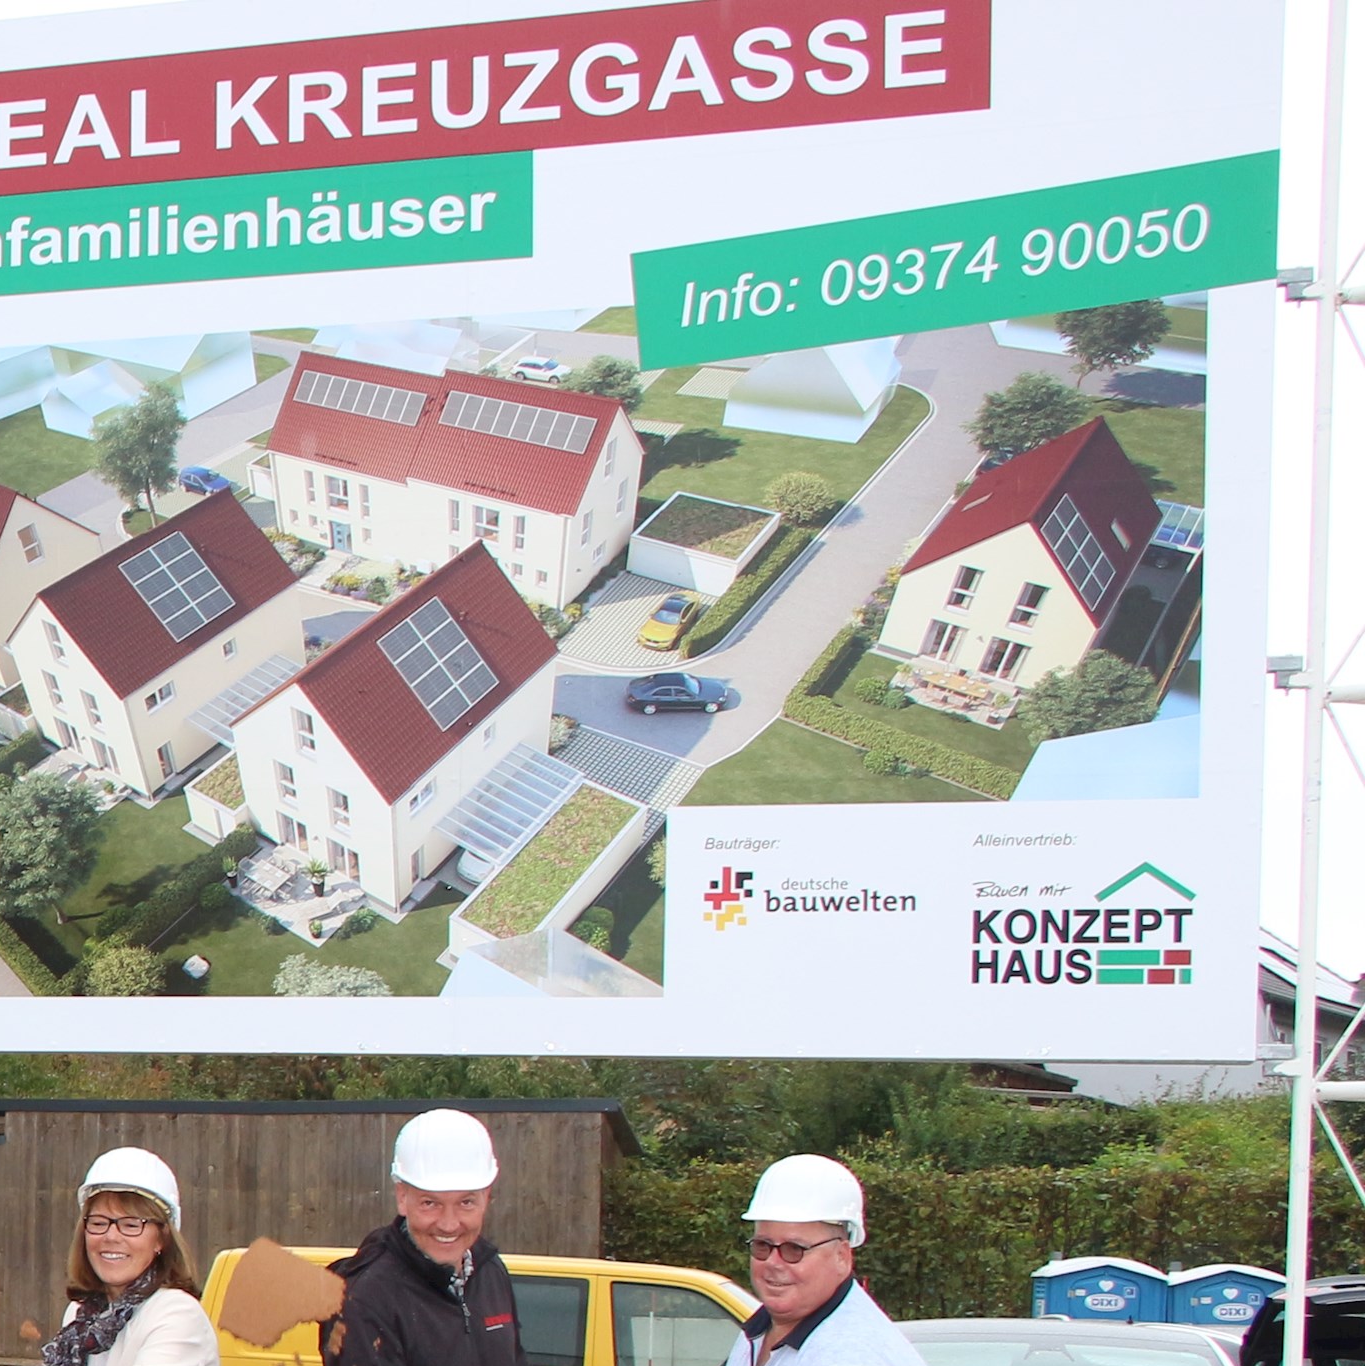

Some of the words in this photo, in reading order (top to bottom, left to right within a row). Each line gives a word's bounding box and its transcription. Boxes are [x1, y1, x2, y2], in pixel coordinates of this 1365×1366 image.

[215, 10, 947, 150] KREUZGASSE
[681, 271, 800, 328] Info:
[820, 235, 1000, 306] 09374
[1021, 202, 1211, 276] 90050
[704, 837, 781, 853] Bauträger:
[972, 833, 1078, 847] Alleinvertrieb:
[781, 877, 849, 891] deutsche
[972, 881, 1029, 899] Bauen
[1038, 884, 1072, 898] mit
[764, 888, 917, 913] bauwelten
[972, 908, 1193, 945] KONZEPT
[971, 948, 1093, 985] HAUS
